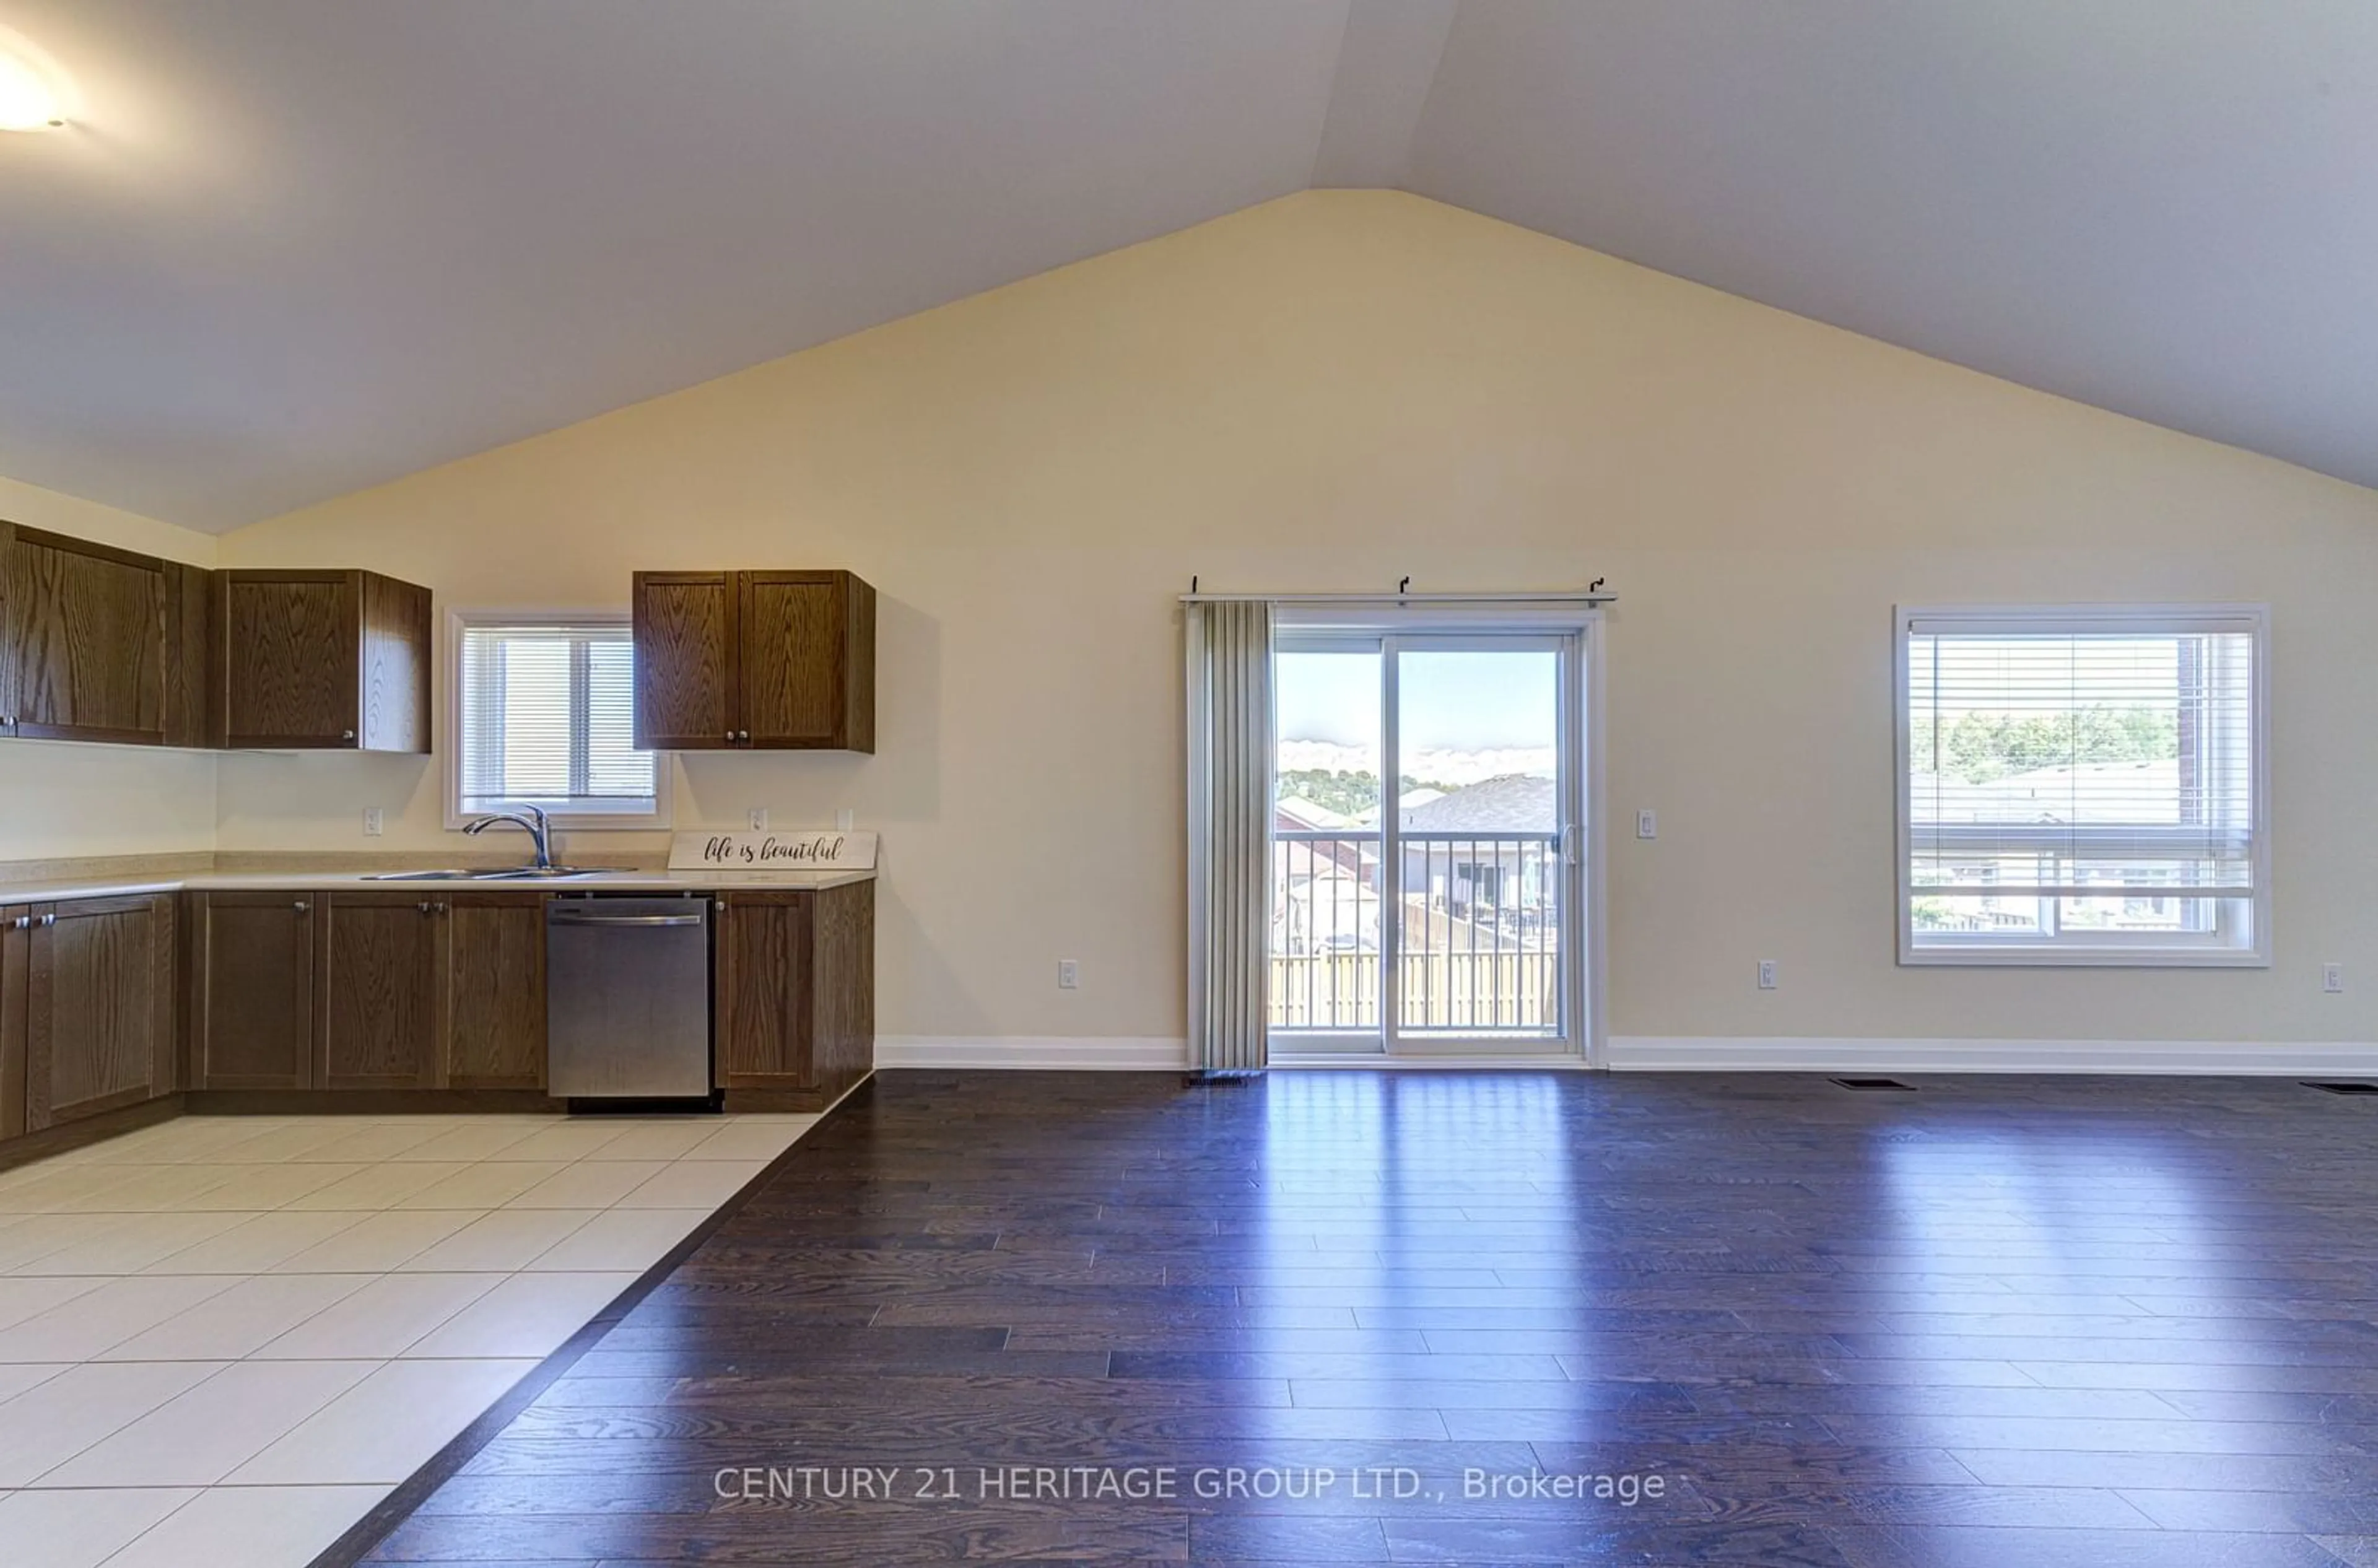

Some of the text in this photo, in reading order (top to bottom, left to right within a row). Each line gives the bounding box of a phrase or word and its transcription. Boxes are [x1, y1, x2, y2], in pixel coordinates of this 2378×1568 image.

[703, 836, 845, 863] life is beautiful
